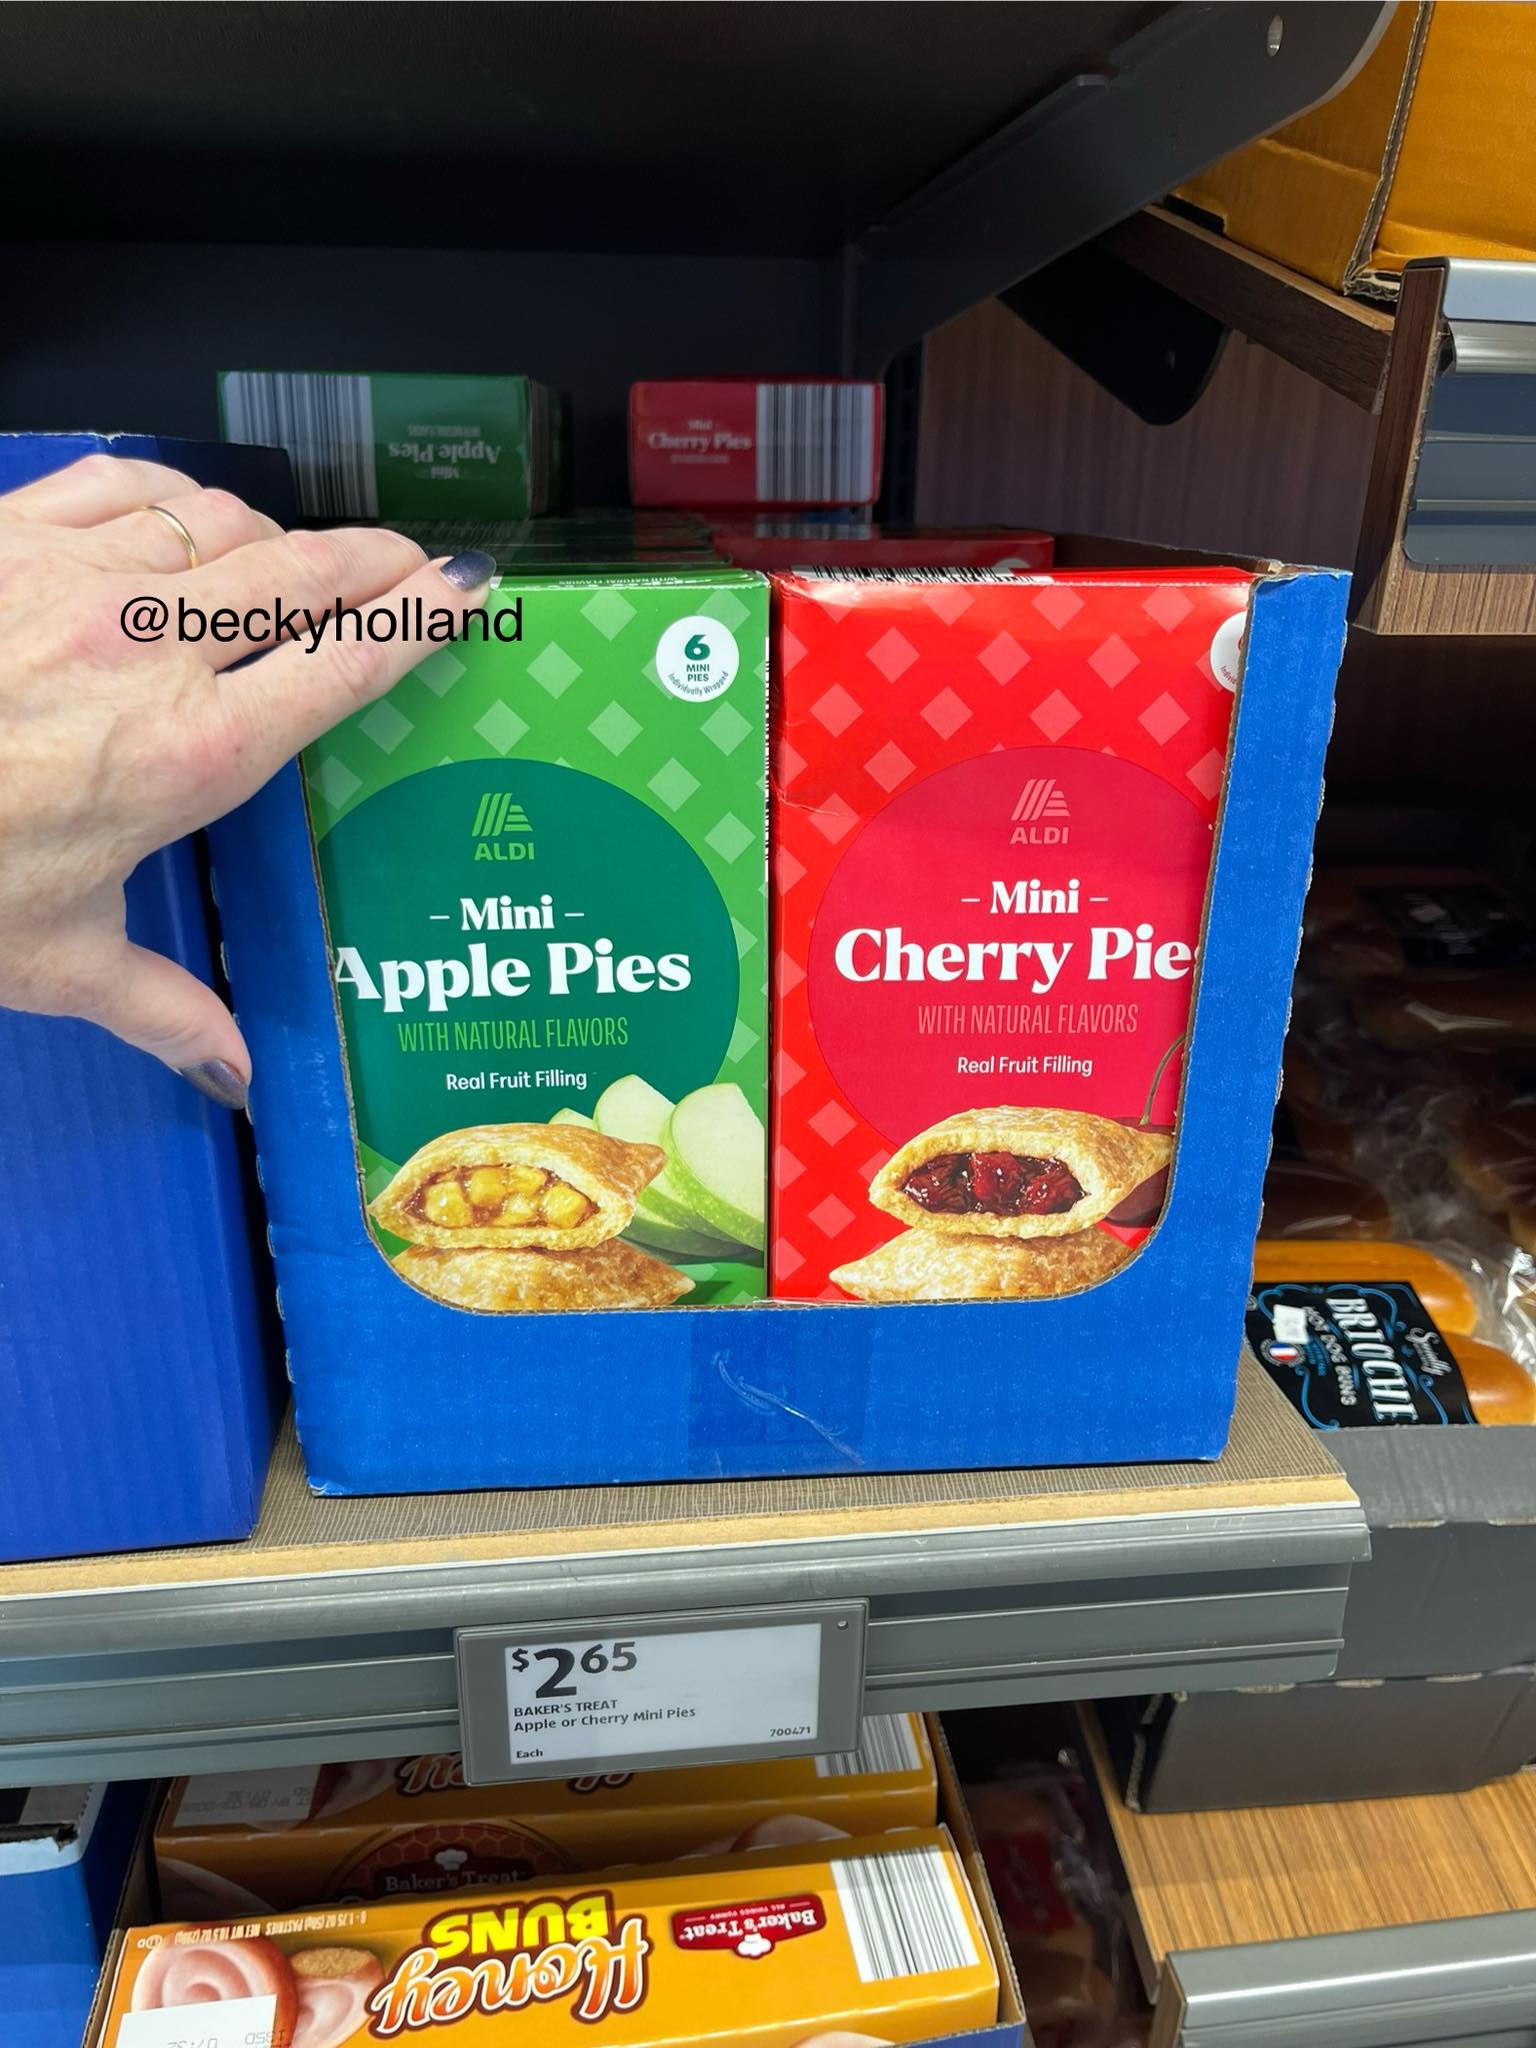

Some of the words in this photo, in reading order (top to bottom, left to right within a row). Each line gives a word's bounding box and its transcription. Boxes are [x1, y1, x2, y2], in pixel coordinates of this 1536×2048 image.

[389, 442, 434, 463] Pies
[439, 440, 501, 464] Apple
[647, 431, 708, 453] Cherry
[713, 432, 752, 449] Pies
[684, 634, 711, 661] 6
[686, 664, 710, 672] MINI
[687, 673, 710, 682] PIES
[668, 672, 703, 696] Individually
[703, 670, 729, 694] Wrapped
[1009, 826, 1069, 845] ALDI
[474, 842, 535, 861] ALDI
[989, 879, 1080, 914] Mini
[460, 895, 555, 931] Mini
[834, 926, 1074, 995] Cherry
[1088, 923, 1200, 981] Pie
[335, 943, 531, 1013] Apple
[547, 938, 692, 995] Pies
[917, 1005, 965, 1035] WITH
[971, 1005, 1052, 1034] NATURAL
[1058, 1004, 1138, 1034] FLAVORS
[398, 1022, 449, 1052] WITH
[454, 1020, 541, 1051] NATURAL
[546, 1017, 629, 1048] FLAVORS
[957, 1057, 995, 1074] Real
[999, 1056, 1039, 1074] Fruit
[1043, 1055, 1093, 1077] Filling
[446, 1072, 485, 1091] Real
[489, 1071, 532, 1089] Fruit
[535, 1070, 588, 1091] Filling
[1320, 1334, 1348, 1364] DOG
[1335, 1365, 1358, 1407] BUNS
[1325, 1297, 1419, 1423] BRIOCHE
[514, 1703, 572, 1717] BAKER'S
[576, 1700, 618, 1712] TREAT
[514, 1718, 557, 1733] Apple
[561, 1718, 577, 1728] or
[581, 1713, 628, 1726] Cherry
[633, 1709, 663, 1721] Mini
[667, 1706, 697, 1718] Pies
[769, 1725, 811, 1737] 700471
[516, 1748, 544, 1759] Each
[385, 1873, 458, 1892] Baker's
[464, 1870, 519, 1885] Treat
[710, 1911, 737, 1920] YUMMY
[739, 1906, 769, 1916] THINGS
[771, 1903, 786, 1911] ALL
[265, 1917, 304, 1936] PASTRIES
[430, 1895, 609, 1961] BUNS
[683, 1920, 743, 1942] Treat
[744, 1908, 817, 1933] Baker's
[230, 1925, 245, 1940] WT
[370, 1918, 649, 2035] Honey
